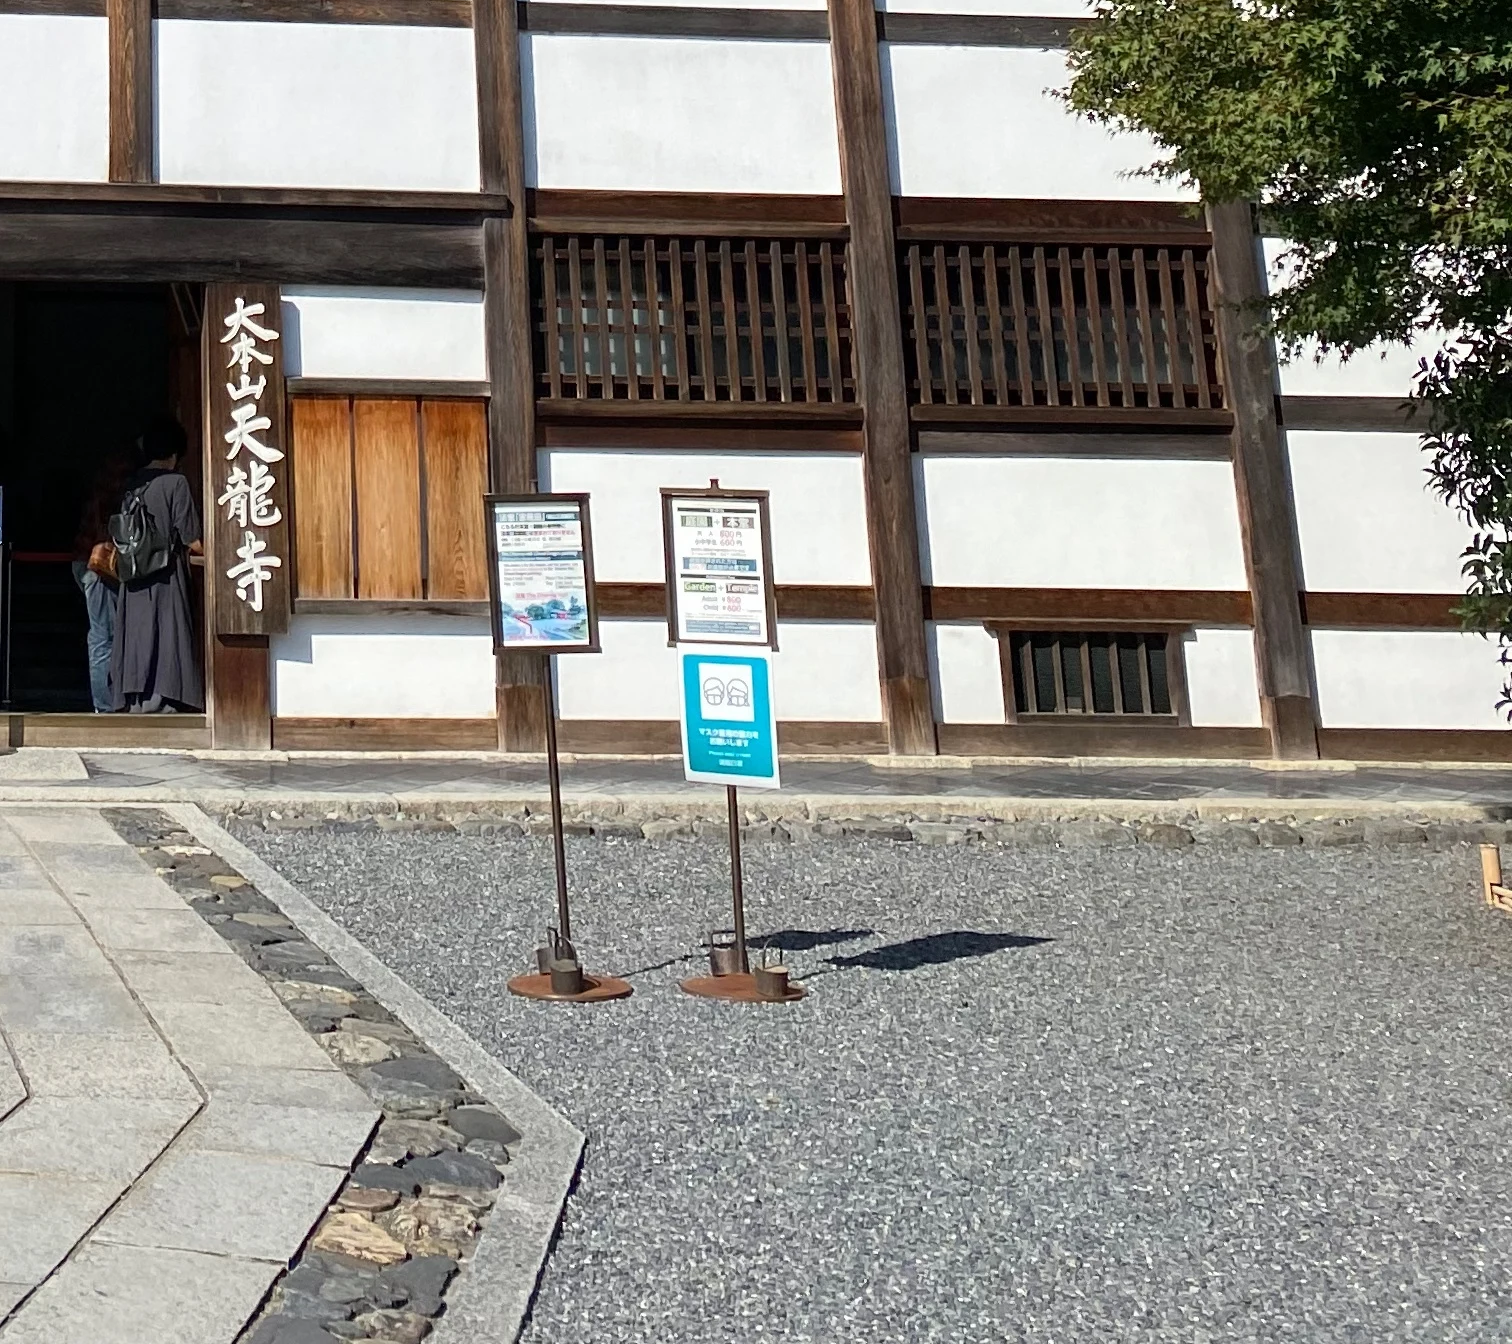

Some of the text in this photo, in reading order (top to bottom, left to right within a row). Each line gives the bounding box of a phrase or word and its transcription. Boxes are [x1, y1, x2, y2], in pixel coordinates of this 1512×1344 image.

[218, 297, 285, 612] 大本山天龍寺
[685, 582, 716, 592] Garden
